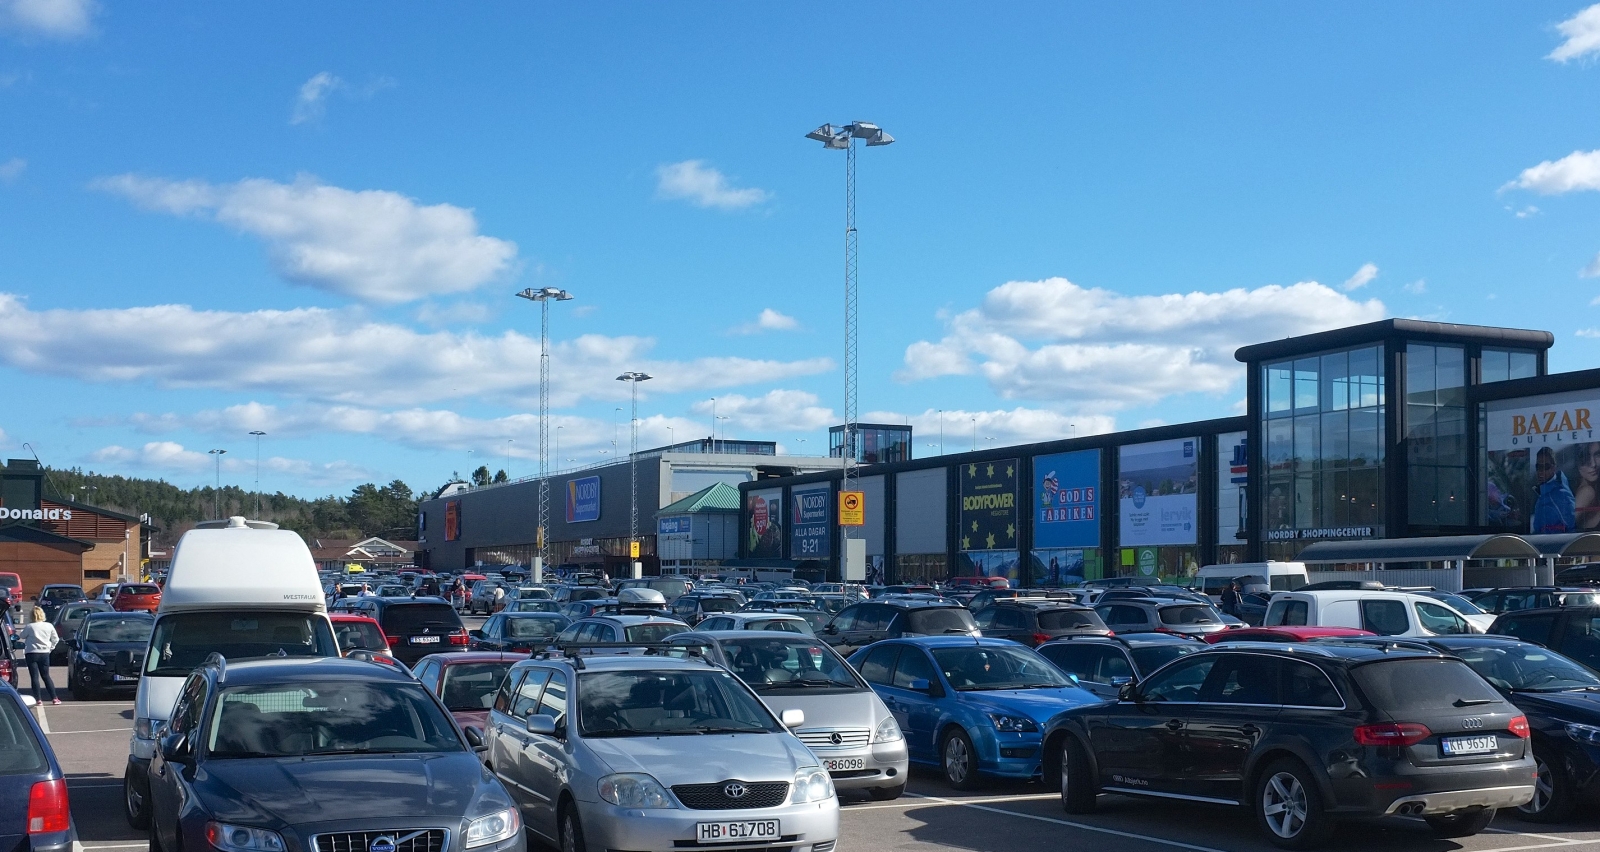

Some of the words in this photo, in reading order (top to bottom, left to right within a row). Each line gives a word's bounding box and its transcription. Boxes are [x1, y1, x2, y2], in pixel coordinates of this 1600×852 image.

[1512, 408, 1592, 436] BAZAR
[1512, 430, 1592, 445] OUTLET
[576, 482, 597, 500] NORDBY
[1060, 489, 1093, 502] GODIS
[803, 496, 825, 508] NORDBY
[963, 493, 1014, 510] BODYPOWER
[0, 507, 72, 520] Donald's
[803, 510, 825, 519] Supermarket
[1041, 507, 1093, 521] FABRIKEN
[795, 529, 808, 537] ALLA
[808, 527, 826, 536] DAGAR
[1268, 530, 1299, 539] NORDBY
[1302, 527, 1372, 538] SHOPPINGCENTER
[1450, 738, 1464, 751] KH
[1466, 736, 1496, 750] 96575
[701, 823, 721, 839] HB
[729, 821, 776, 838] 61708
